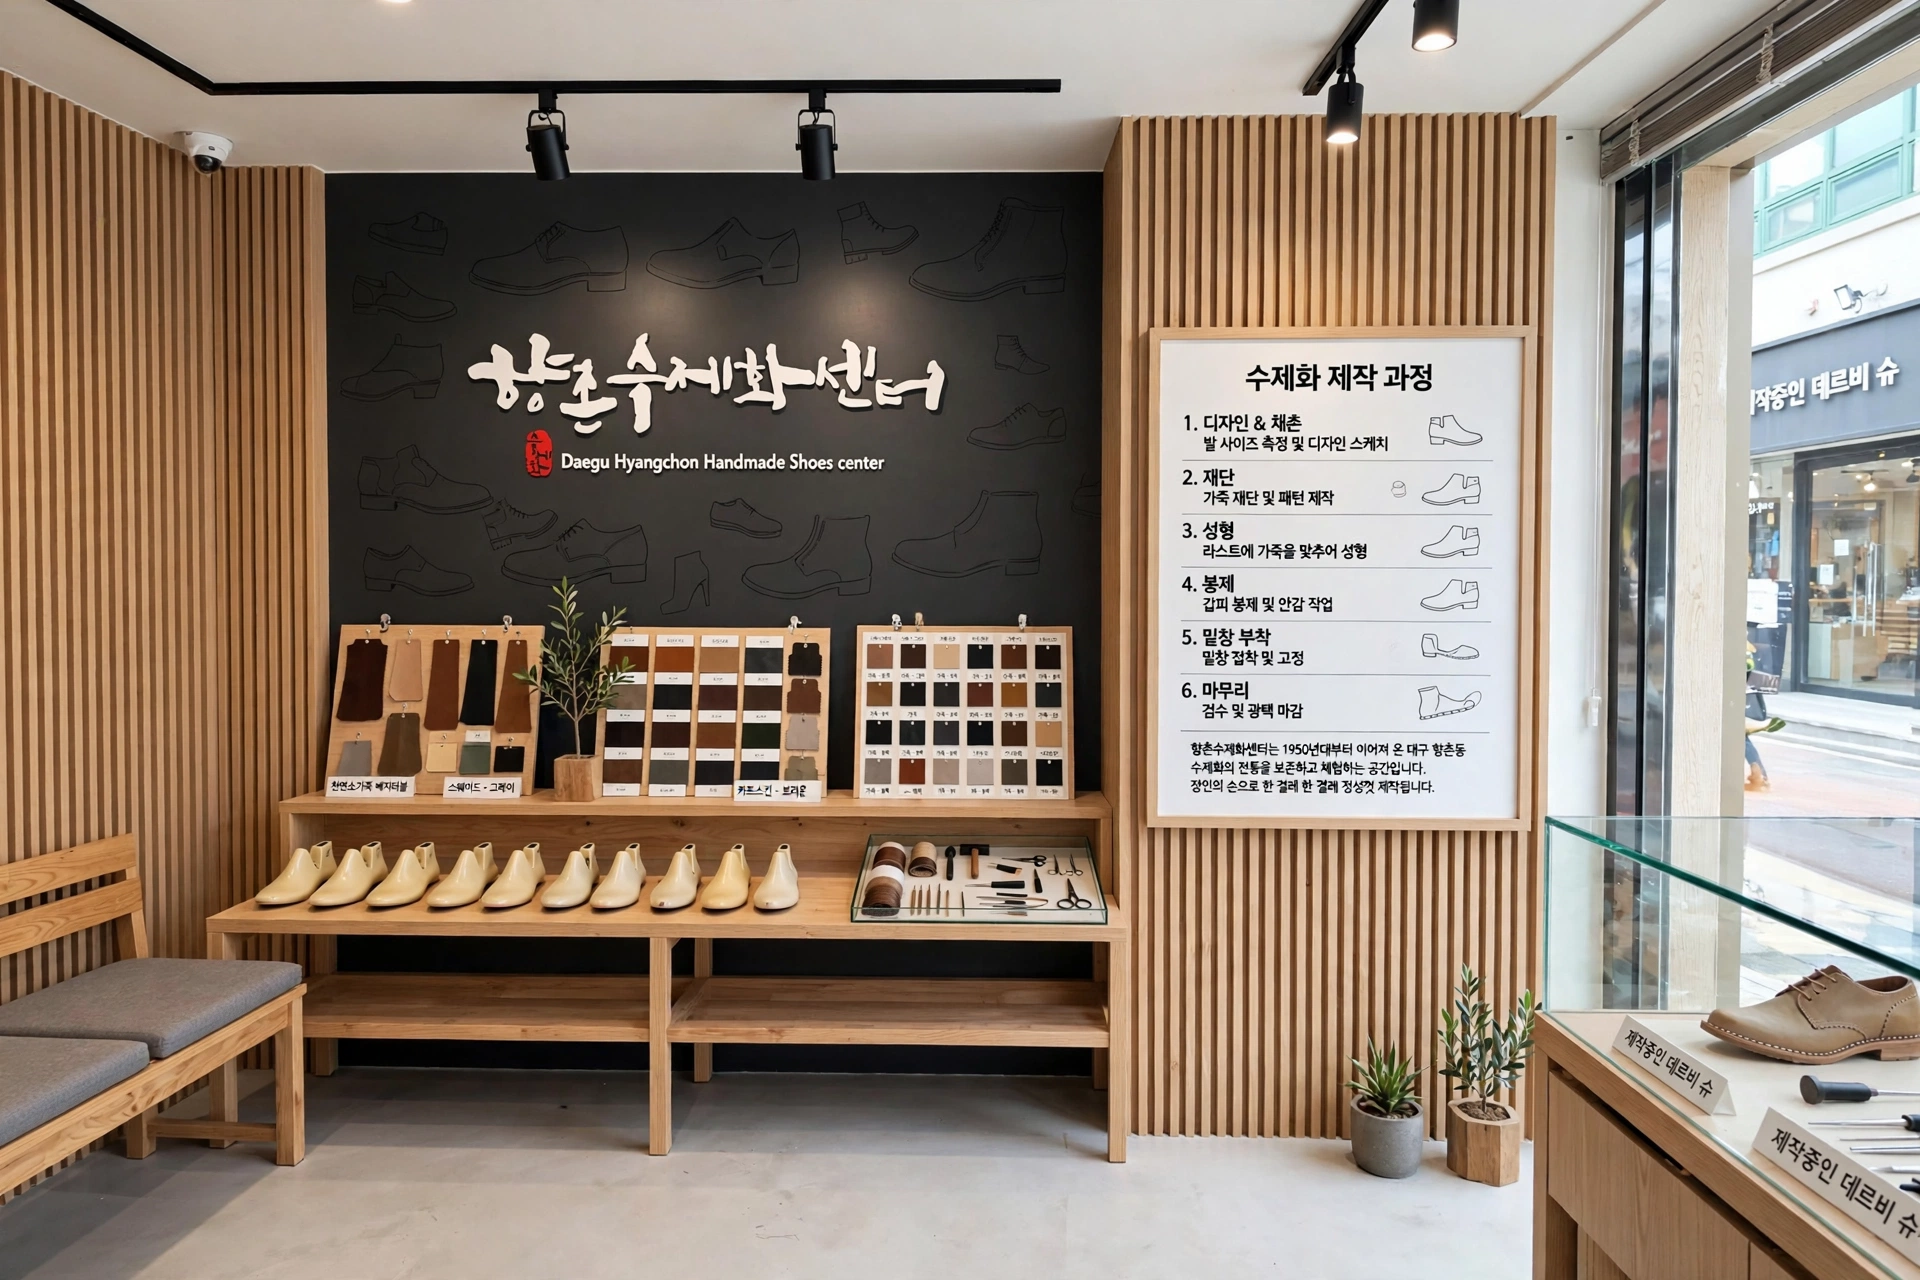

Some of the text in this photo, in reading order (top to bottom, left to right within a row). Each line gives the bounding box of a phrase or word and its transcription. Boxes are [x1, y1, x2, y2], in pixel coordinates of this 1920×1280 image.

[1246, 364, 1432, 391] 수제화 제작 과정
[1812, 362, 1869, 400] 데르비
[1876, 357, 1899, 386] 슈
[1185, 414, 1302, 432] 1. 디자인 & 채촌
[1204, 435, 1387, 451] 발 사이즈 측정 및 디자인 스케치
[562, 453, 884, 473] Daegu Hyangchon Handmade Shoes center
[1183, 469, 1235, 487] 2. 재단
[1204, 490, 1334, 506] 가죽 재단 및 패턴 제작
[1183, 521, 1233, 540] 3. 성형
[1203, 543, 1366, 559] 라스트에 가죽을 맞추어 성형
[1182, 574, 1234, 593] 4. 봉제
[1203, 597, 1332, 612] 갑피 봉제 및 안감 작업
[1182, 628, 1271, 647] 5. 밑창 부착
[1231, 650, 1258, 665] 접착
[1262, 651, 1273, 666] 및
[1277, 651, 1303, 666] 고정
[1182, 681, 1248, 700] 6. 마무리
[1203, 703, 1303, 719] 검수 및 광택 마감
[1283, 743, 1352, 756] 1950년대부터
[1357, 743, 1388, 756] 이어져
[1393, 743, 1404, 756] 온
[1407, 744, 1428, 756] 대구
[1274, 761, 1317, 775] 보존하고
[1368, 762, 1425, 775] 공간입니다.
[1227, 781, 1259, 793] 손으로
[1262, 780, 1274, 792] 한
[1302, 780, 1312, 793] 한
[1624, 1029, 1713, 1098] 제작중인 데르비 슈
[1771, 1128, 1838, 1184] 제작중인
[1840, 1172, 1896, 1224] 데르비
